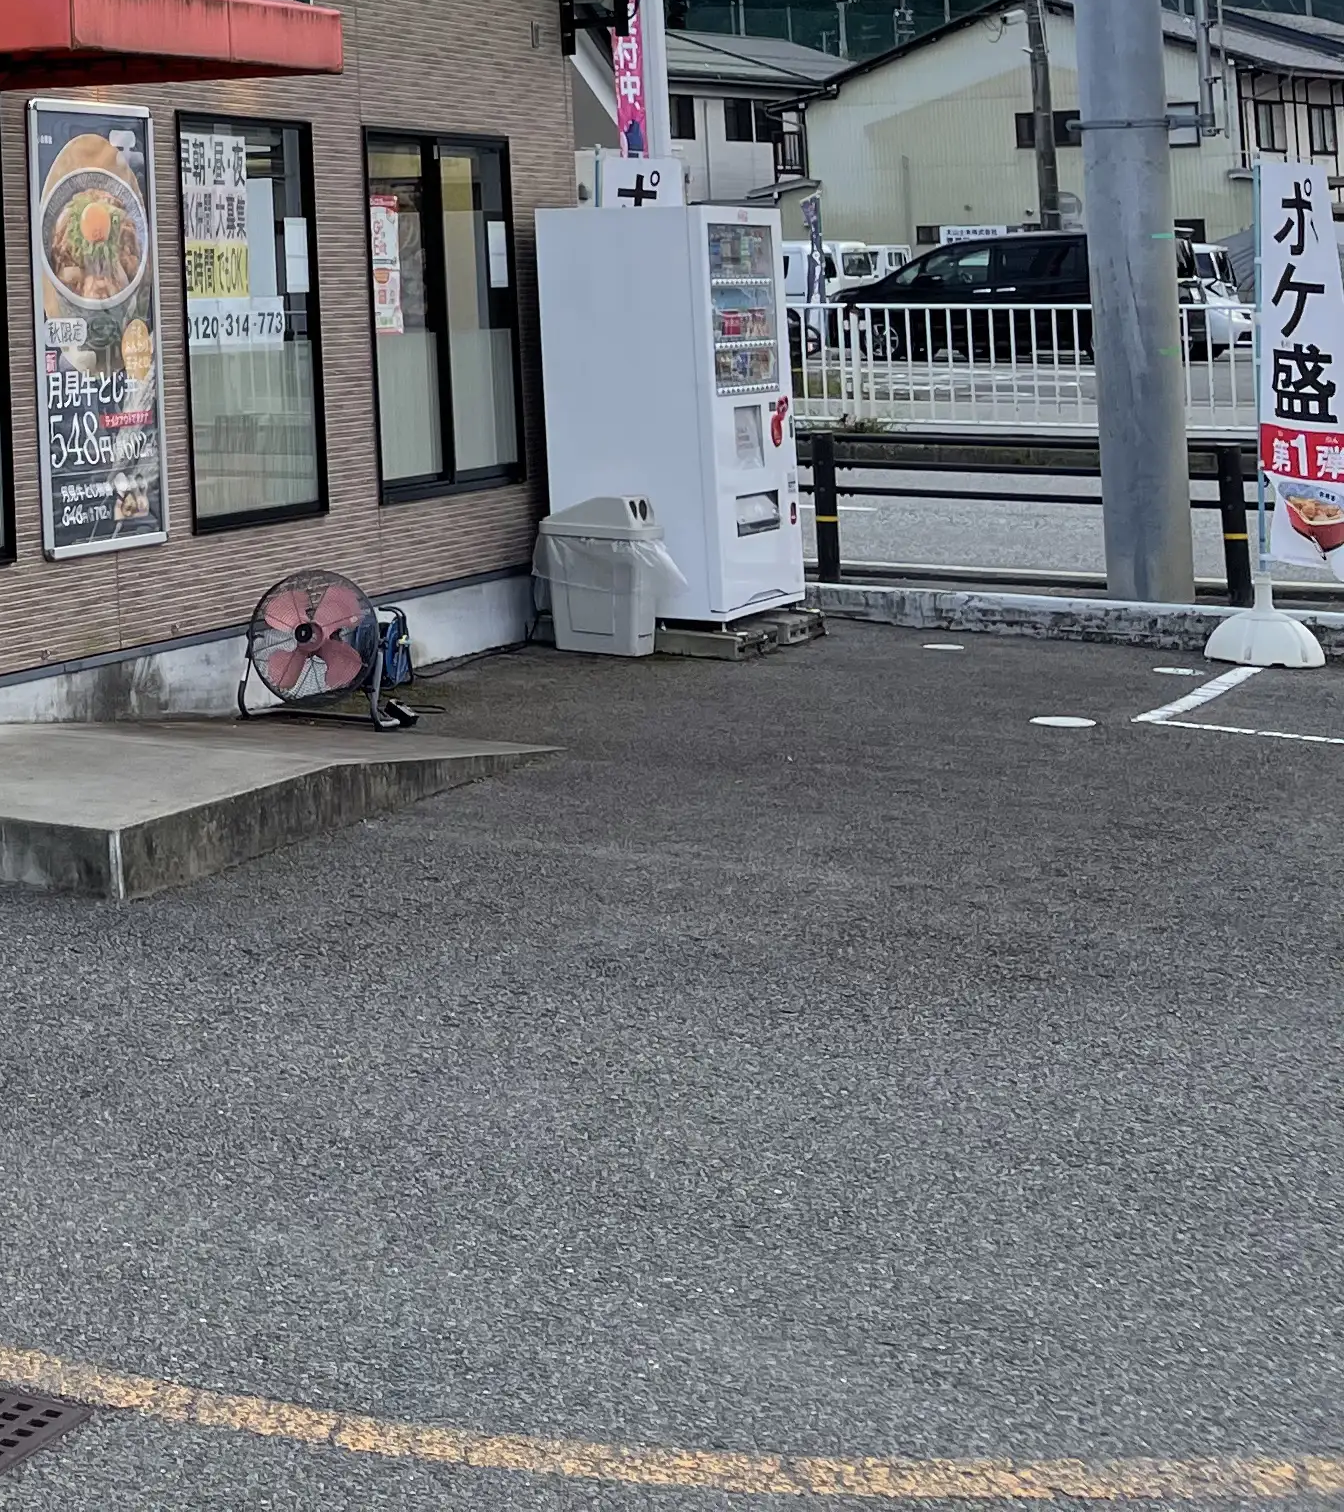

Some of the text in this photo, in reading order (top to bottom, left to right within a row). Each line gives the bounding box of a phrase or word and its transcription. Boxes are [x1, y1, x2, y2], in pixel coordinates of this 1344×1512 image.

[1271, 177, 1338, 424] ポケ盛
[47, 321, 84, 343] 秋限定
[47, 369, 139, 409] 月見牛とじ丼
[1272, 433, 1344, 480] 第1弾
